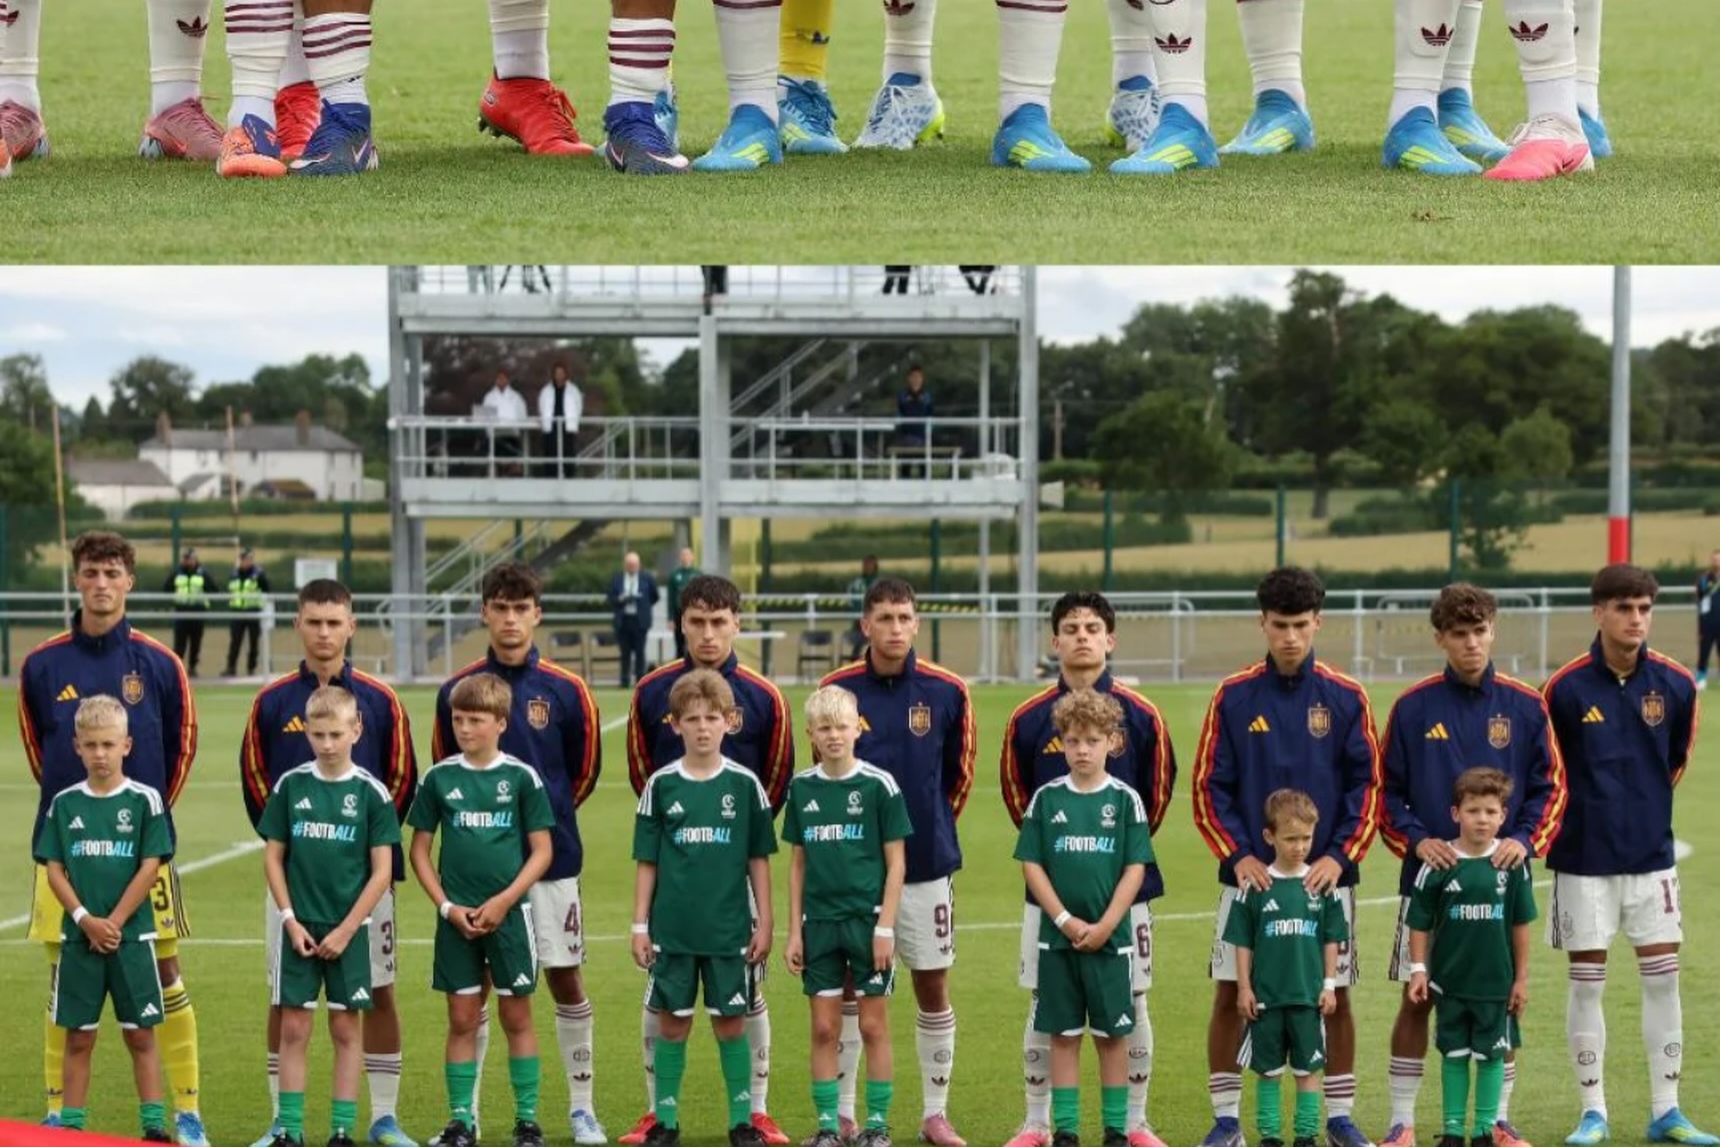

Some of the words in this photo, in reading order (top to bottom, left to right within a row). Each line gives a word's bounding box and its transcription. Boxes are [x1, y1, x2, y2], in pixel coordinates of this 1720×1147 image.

[452, 811, 512, 827] #FOOTBALL
[292, 820, 357, 842] #FOOTBALL
[674, 826, 731, 844] #FOOTBALL
[803, 824, 864, 842] #FOOTBALL
[71, 839, 134, 857] #FOOTBALL
[1054, 835, 1115, 853] #FOOTBALL
[564, 902, 580, 936] 4
[934, 903, 950, 938] 9
[381, 921, 393, 955] 3
[1136, 923, 1150, 959] 6
